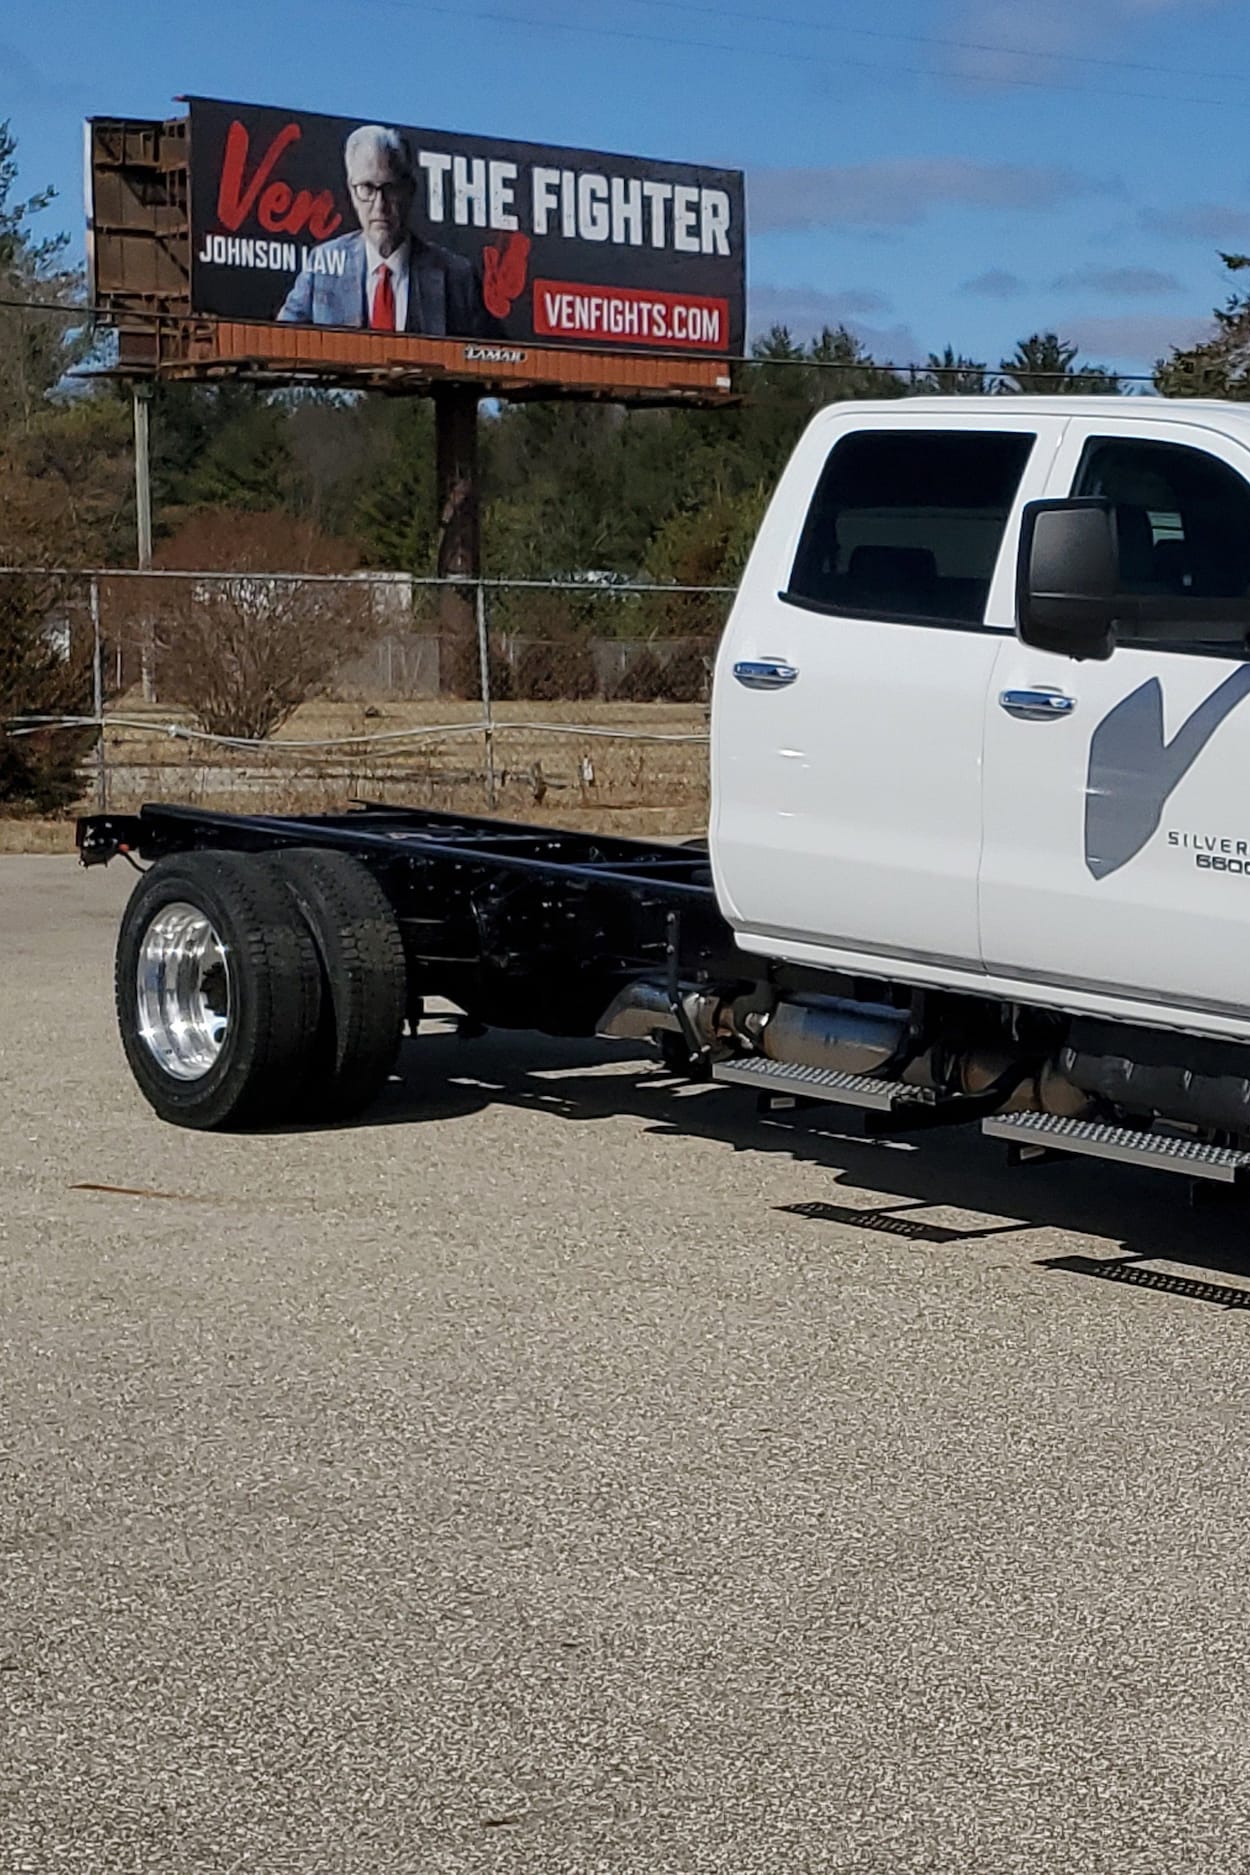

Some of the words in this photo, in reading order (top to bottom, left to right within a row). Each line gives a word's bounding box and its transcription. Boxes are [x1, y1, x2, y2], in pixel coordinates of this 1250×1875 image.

[217, 120, 342, 240] Ven
[418, 151, 519, 231] THE
[532, 166, 731, 256] FIGHTER
[199, 234, 297, 272] JOHNSON
[301, 245, 346, 276] LAW
[543, 291, 720, 343] VENFIGHTS.COM
